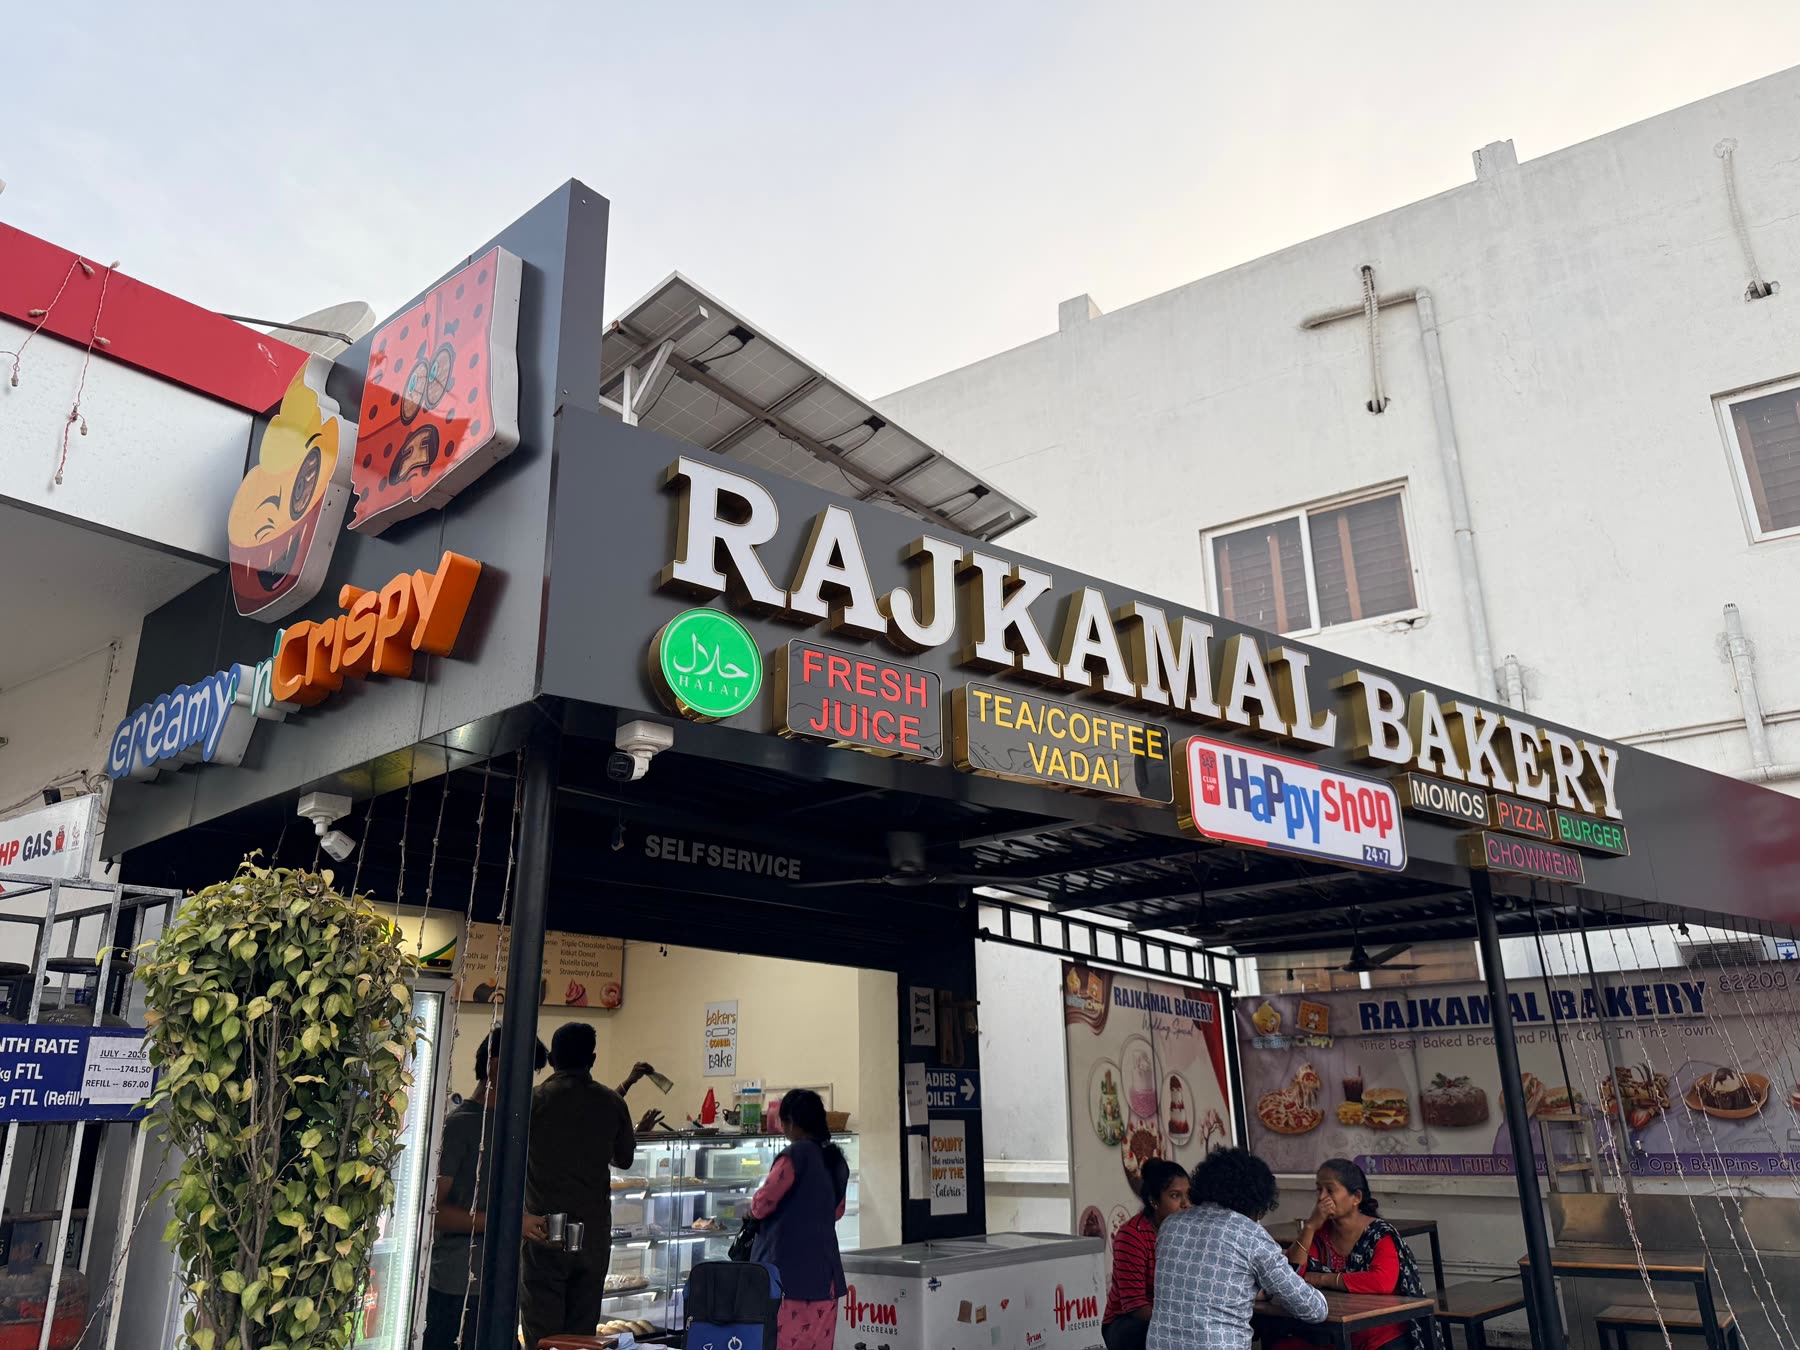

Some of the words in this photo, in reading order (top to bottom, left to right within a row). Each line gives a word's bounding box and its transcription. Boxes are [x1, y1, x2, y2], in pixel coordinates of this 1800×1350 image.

[667, 455, 1337, 748] RAJKAMAL
[1353, 668, 1624, 820] BAKERY
[673, 632, 750, 679] حلال
[678, 674, 741, 698] HALAL
[802, 649, 928, 709] FRESH
[809, 697, 922, 751] JUICE
[972, 690, 1164, 760] TEA/COFFEE
[1027, 741, 1120, 790] VADAI
[1202, 775, 1217, 785] CLUB
[1412, 779, 1485, 819] MOMOS
[1499, 801, 1548, 833] PIZZA
[1559, 816, 1624, 850] BURGER
[0, 839, 20, 867] HP
[22, 829, 53, 862] GAS
[644, 834, 705, 865] SELF
[706, 844, 801, 880] SERVICE
[1487, 838, 1580, 878] CHOWMEIN
[578, 951, 596, 959] Donut
[581, 960, 599, 968] Donut
[559, 968, 590, 979] Strawberry
[596, 971, 614, 979] Donut
[1113, 985, 1173, 1016] RAJKAMAL
[1174, 995, 1214, 1024] BAKERY
[1551, 980, 1706, 1021] BAKERY
[34, 1037, 80, 1054] RATE
[1390, 1037, 1418, 1051] Best
[1423, 1034, 1463, 1048] Baked
[1467, 1033, 1497, 1046] Bre
[1615, 1026, 1634, 1040] In
[1638, 1025, 1669, 1039] The
[100, 1049, 119, 1058] JULY
[15, 1063, 44, 1081] FTL
[88, 1064, 101, 1072] FTL
[925, 1072, 957, 1087] ADIES
[85, 1079, 111, 1088] REFILL
[122, 1080, 149, 1089] 867.00
[10, 1089, 39, 1107] FTL
[927, 1091, 957, 1106] OILET
[931, 1136, 964, 1153] COUNT
[1461, 1157, 1510, 1173] FUELS
[1649, 1157, 1686, 1174] Opp.
[1691, 1157, 1721, 1172] Bell
[1725, 1157, 1764, 1173] Pins,
[842, 1284, 898, 1330] Arun
[1053, 1283, 1099, 1332] Arun
[859, 1325, 899, 1336] ICECREAMS
[1066, 1319, 1101, 1332] ICECREAMS
